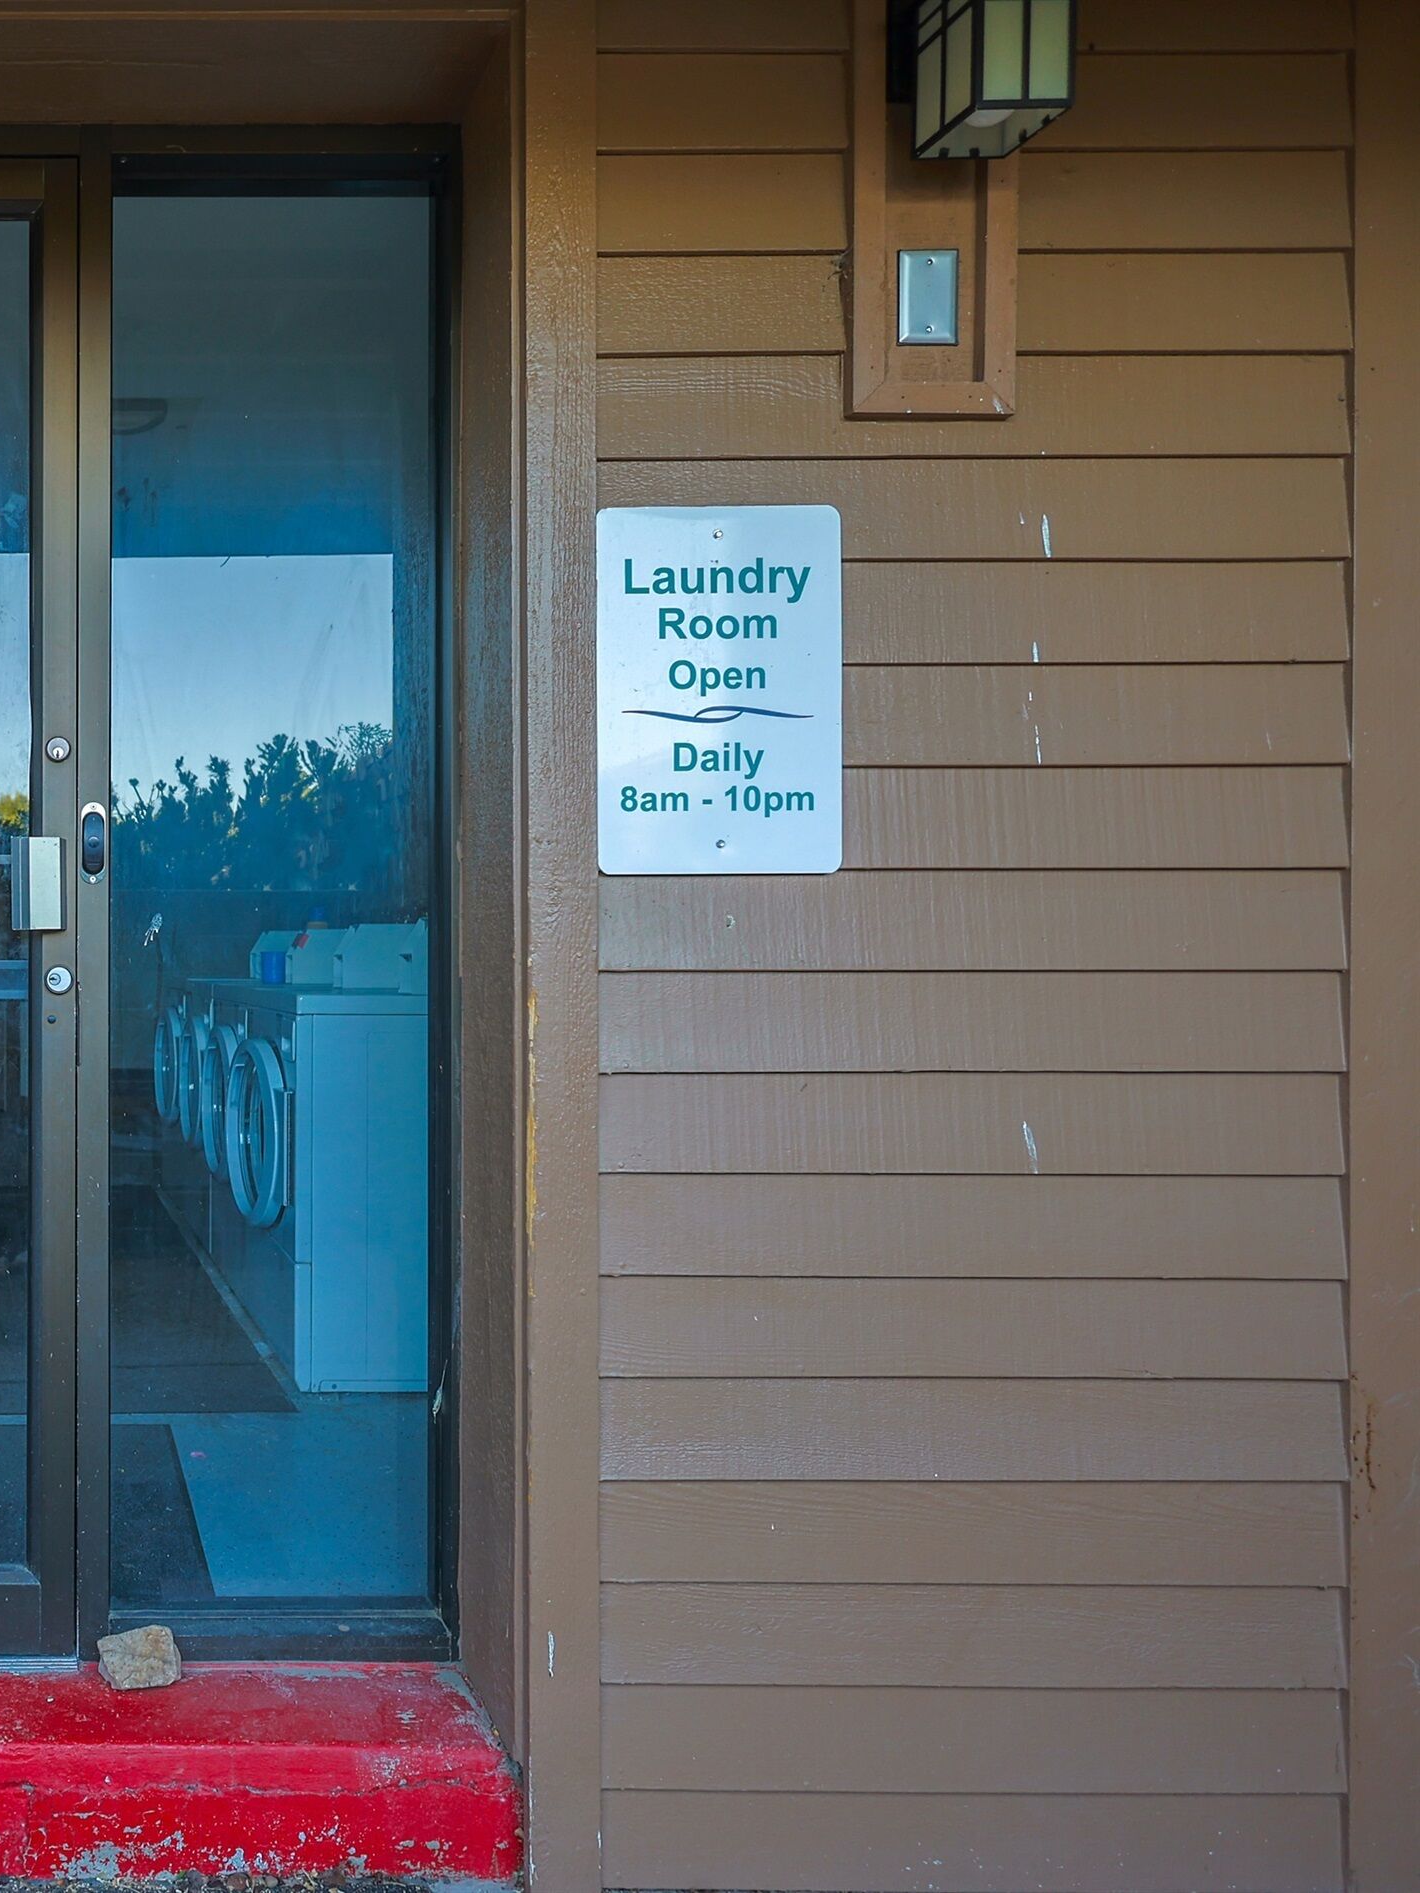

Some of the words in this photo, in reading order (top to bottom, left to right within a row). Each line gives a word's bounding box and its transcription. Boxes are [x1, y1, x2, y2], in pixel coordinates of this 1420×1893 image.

[625, 558, 811, 603] Laundry
[659, 608, 777, 639] Room
[669, 660, 765, 696] Open
[674, 742, 764, 779] Daily
[621, 786, 688, 812] 8am
[725, 786, 814, 817] 10pm
